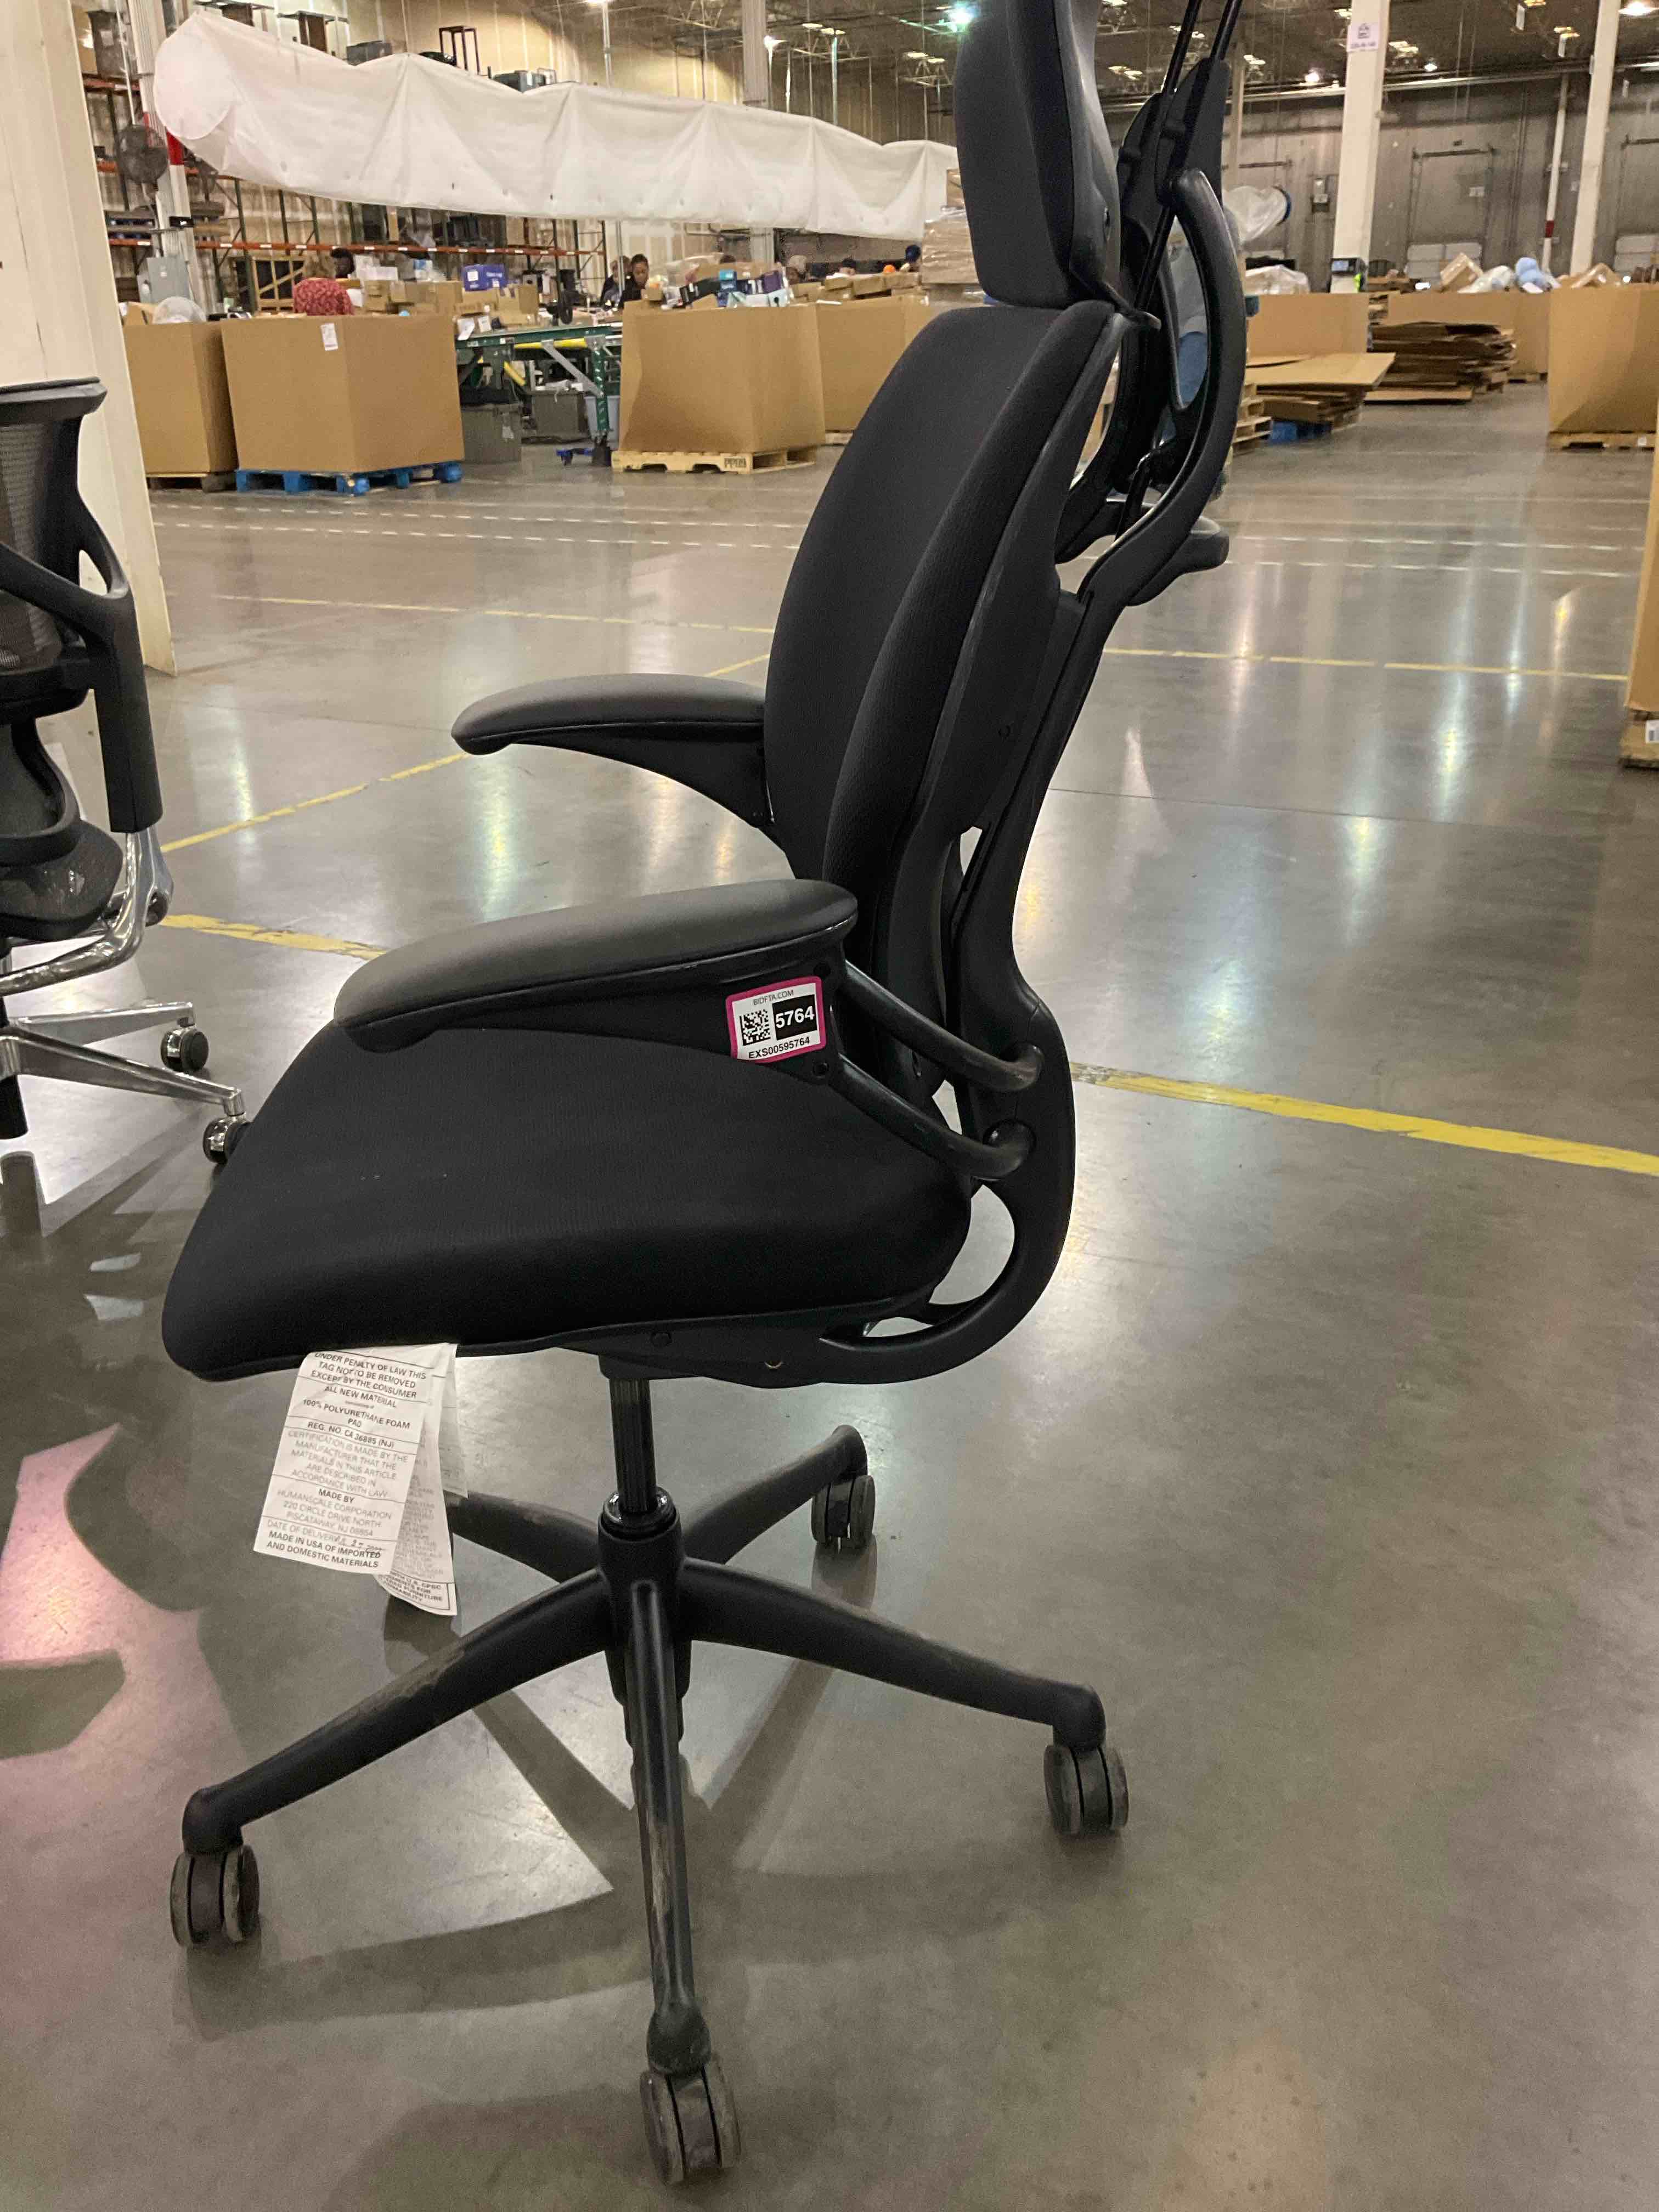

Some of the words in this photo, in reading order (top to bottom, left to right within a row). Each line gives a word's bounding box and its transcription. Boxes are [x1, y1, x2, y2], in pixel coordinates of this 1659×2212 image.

[753, 990, 794, 1006] BIDFTA.COM
[775, 1006, 815, 1029] 5764
[748, 1036, 810, 1059] EXS00595764
[314, 1353, 342, 1363] UNDER
[343, 1358, 375, 1370] PENALTY
[389, 1367, 407, 1375] LAW
[409, 1370, 426, 1379] THIS
[318, 1361, 334, 1371] TAG
[335, 1365, 352, 1375] NOT
[378, 1374, 416, 1388] REMOVED
[311, 1370, 341, 1383] EXCEPT
[356, 1379, 370, 1387] THE
[373, 1383, 416, 1398] CONSUMER
[324, 1385, 337, 1393] ALL
[339, 1388, 359, 1398] NEW
[360, 1392, 397, 1408] MATERIAL
[302, 1398, 321, 1408] 100%
[323, 1404, 383, 1424] POLYURETHANE
[386, 1418, 410, 1429] FOAM
[287, 1429, 342, 1447] CERTIFICATION
[354, 1444, 378, 1457] MADE
[380, 1451, 390, 1459] BY
[393, 1453, 409, 1463] THE
[295, 1440, 357, 1462] MANUFACTURER
[359, 1457, 379, 1466] THAT
[381, 1461, 396, 1470] THE
[378, 1438, 394, 1448] (NJ)
[290, 1449, 334, 1465] MATERIALS
[345, 1463, 363, 1473] THIS
[364, 1468, 397, 1480] ARTICLE
[306, 1463, 321, 1472] ARE
[324, 1467, 366, 1484] DESCRIBED
[368, 1479, 376, 1487] IN
[291, 1469, 343, 1488] ACCORDANCE
[346, 1483, 368, 1493] WITH
[368, 1488, 388, 1498] LAW
[318, 1488, 342, 1500] MADE
[343, 1496, 354, 1504] BY
[276, 1488, 331, 1508] HUMANSCALE
[334, 1502, 391, 1520] CORPORATION
[283, 1500, 297, 1510] 220
[299, 1504, 325, 1517] CIRCLE
[328, 1511, 351, 1523] DRIVE
[352, 1516, 382, 1528] NORTH
[267, 1519, 287, 1531] DATE
[289, 1525, 301, 1533] OF
[337, 1523, 348, 1532] NJ
[266, 1541, 285, 1550] AND
[287, 1545, 330, 1561] DOMESTIC
[331, 1555, 378, 1568] MATERIALS
[268, 1531, 294, 1543] MADE
[306, 1539, 323, 1549] USA
[325, 1544, 335, 1552] OF
[337, 1546, 381, 1559] IMPORTED
